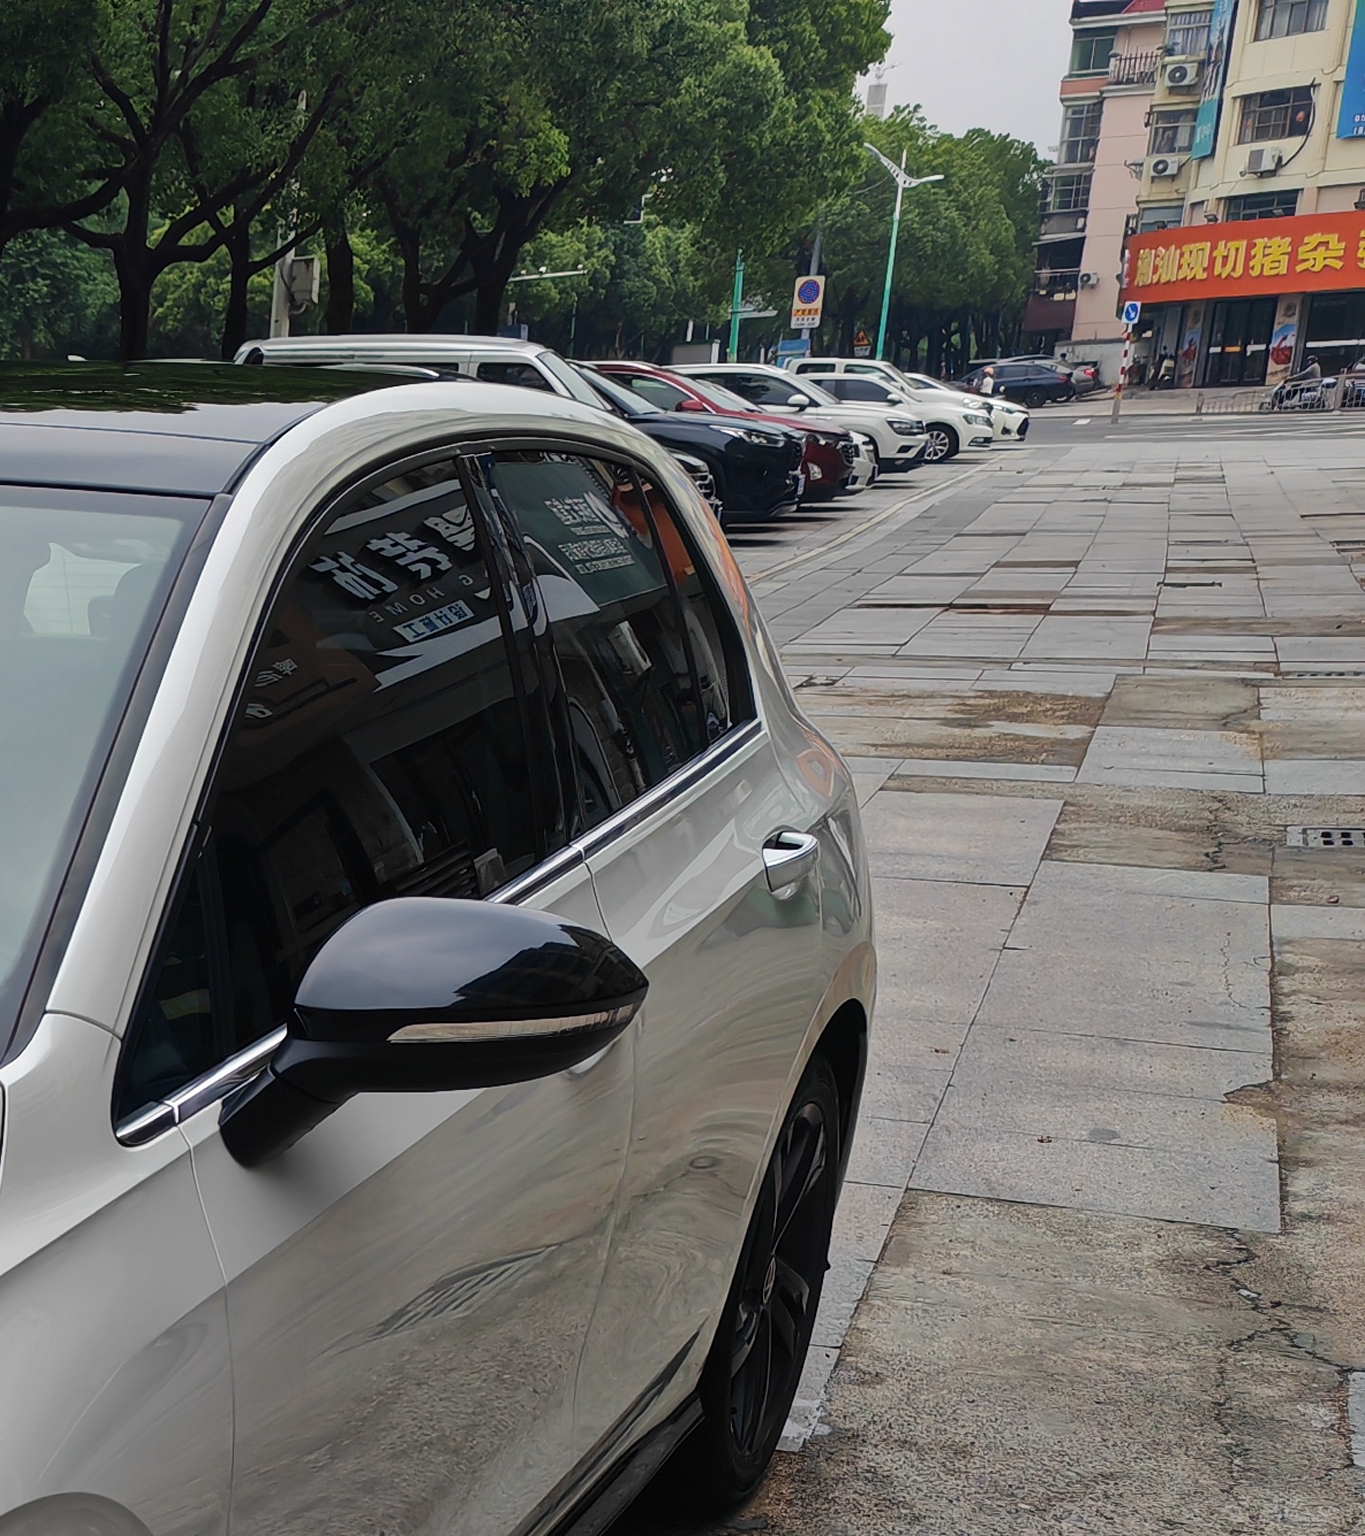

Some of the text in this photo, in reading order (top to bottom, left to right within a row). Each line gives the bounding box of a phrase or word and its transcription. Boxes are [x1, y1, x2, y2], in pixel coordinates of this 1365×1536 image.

[1134, 230, 1365, 287] 潮汕现切猪杂
